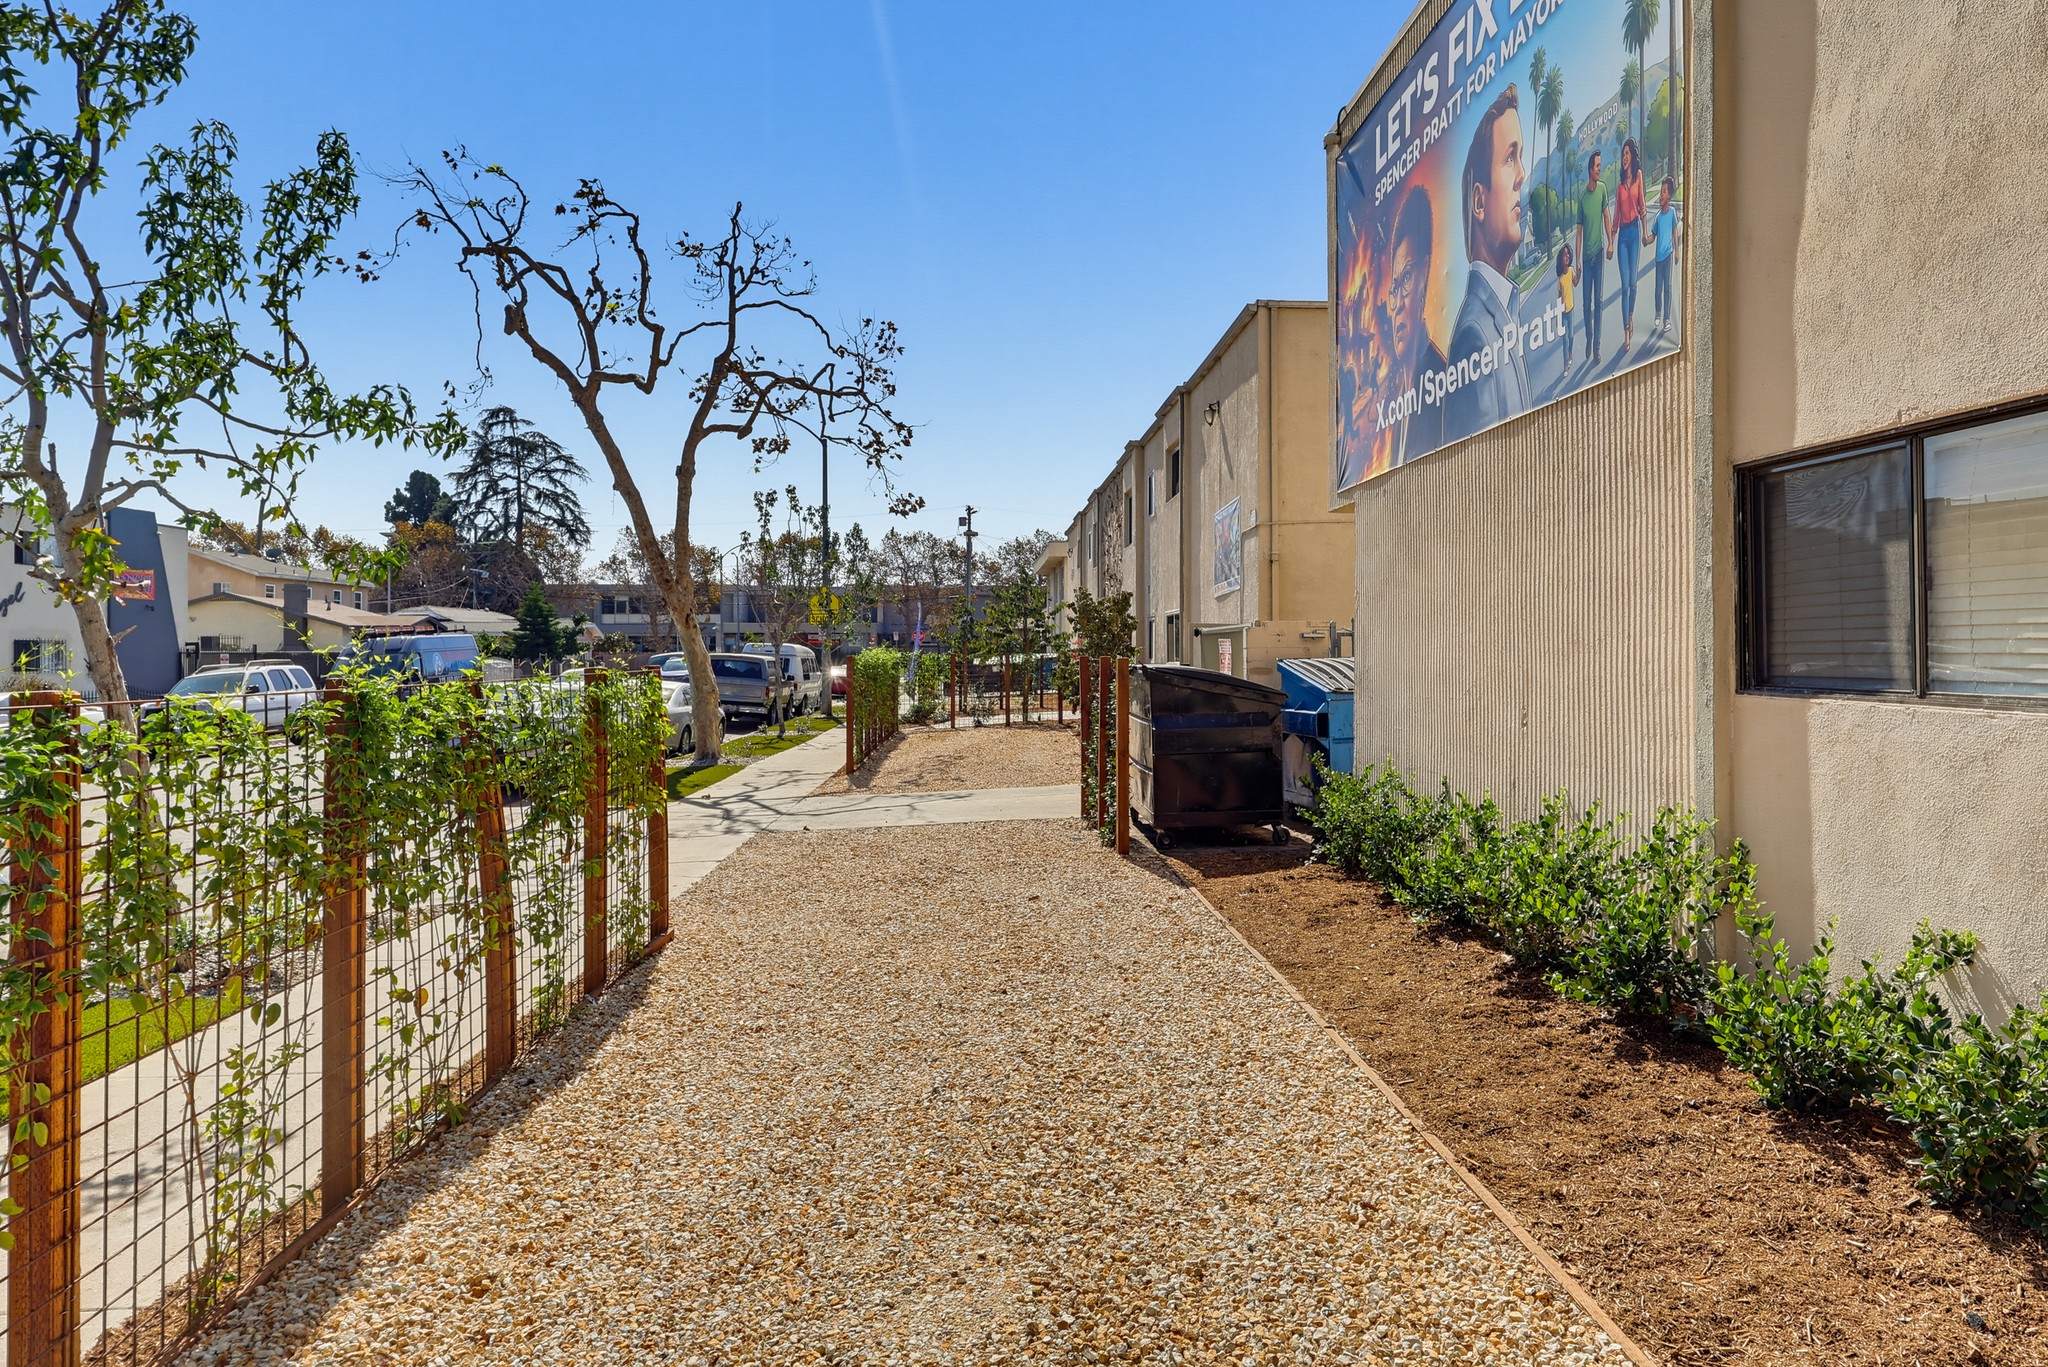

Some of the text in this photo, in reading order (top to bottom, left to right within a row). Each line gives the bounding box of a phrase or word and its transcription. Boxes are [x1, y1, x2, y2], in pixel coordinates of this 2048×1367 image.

[1375, 0, 1498, 174] LET'S FIX
[1375, 138, 1420, 207] SPENCER
[1423, 86, 1464, 152] PRATT
[1466, 52, 1496, 105] FOR
[1578, 102, 1618, 142] HOLLYWOOD
[1375, 297, 1567, 432] X.com/SpencerPratt
